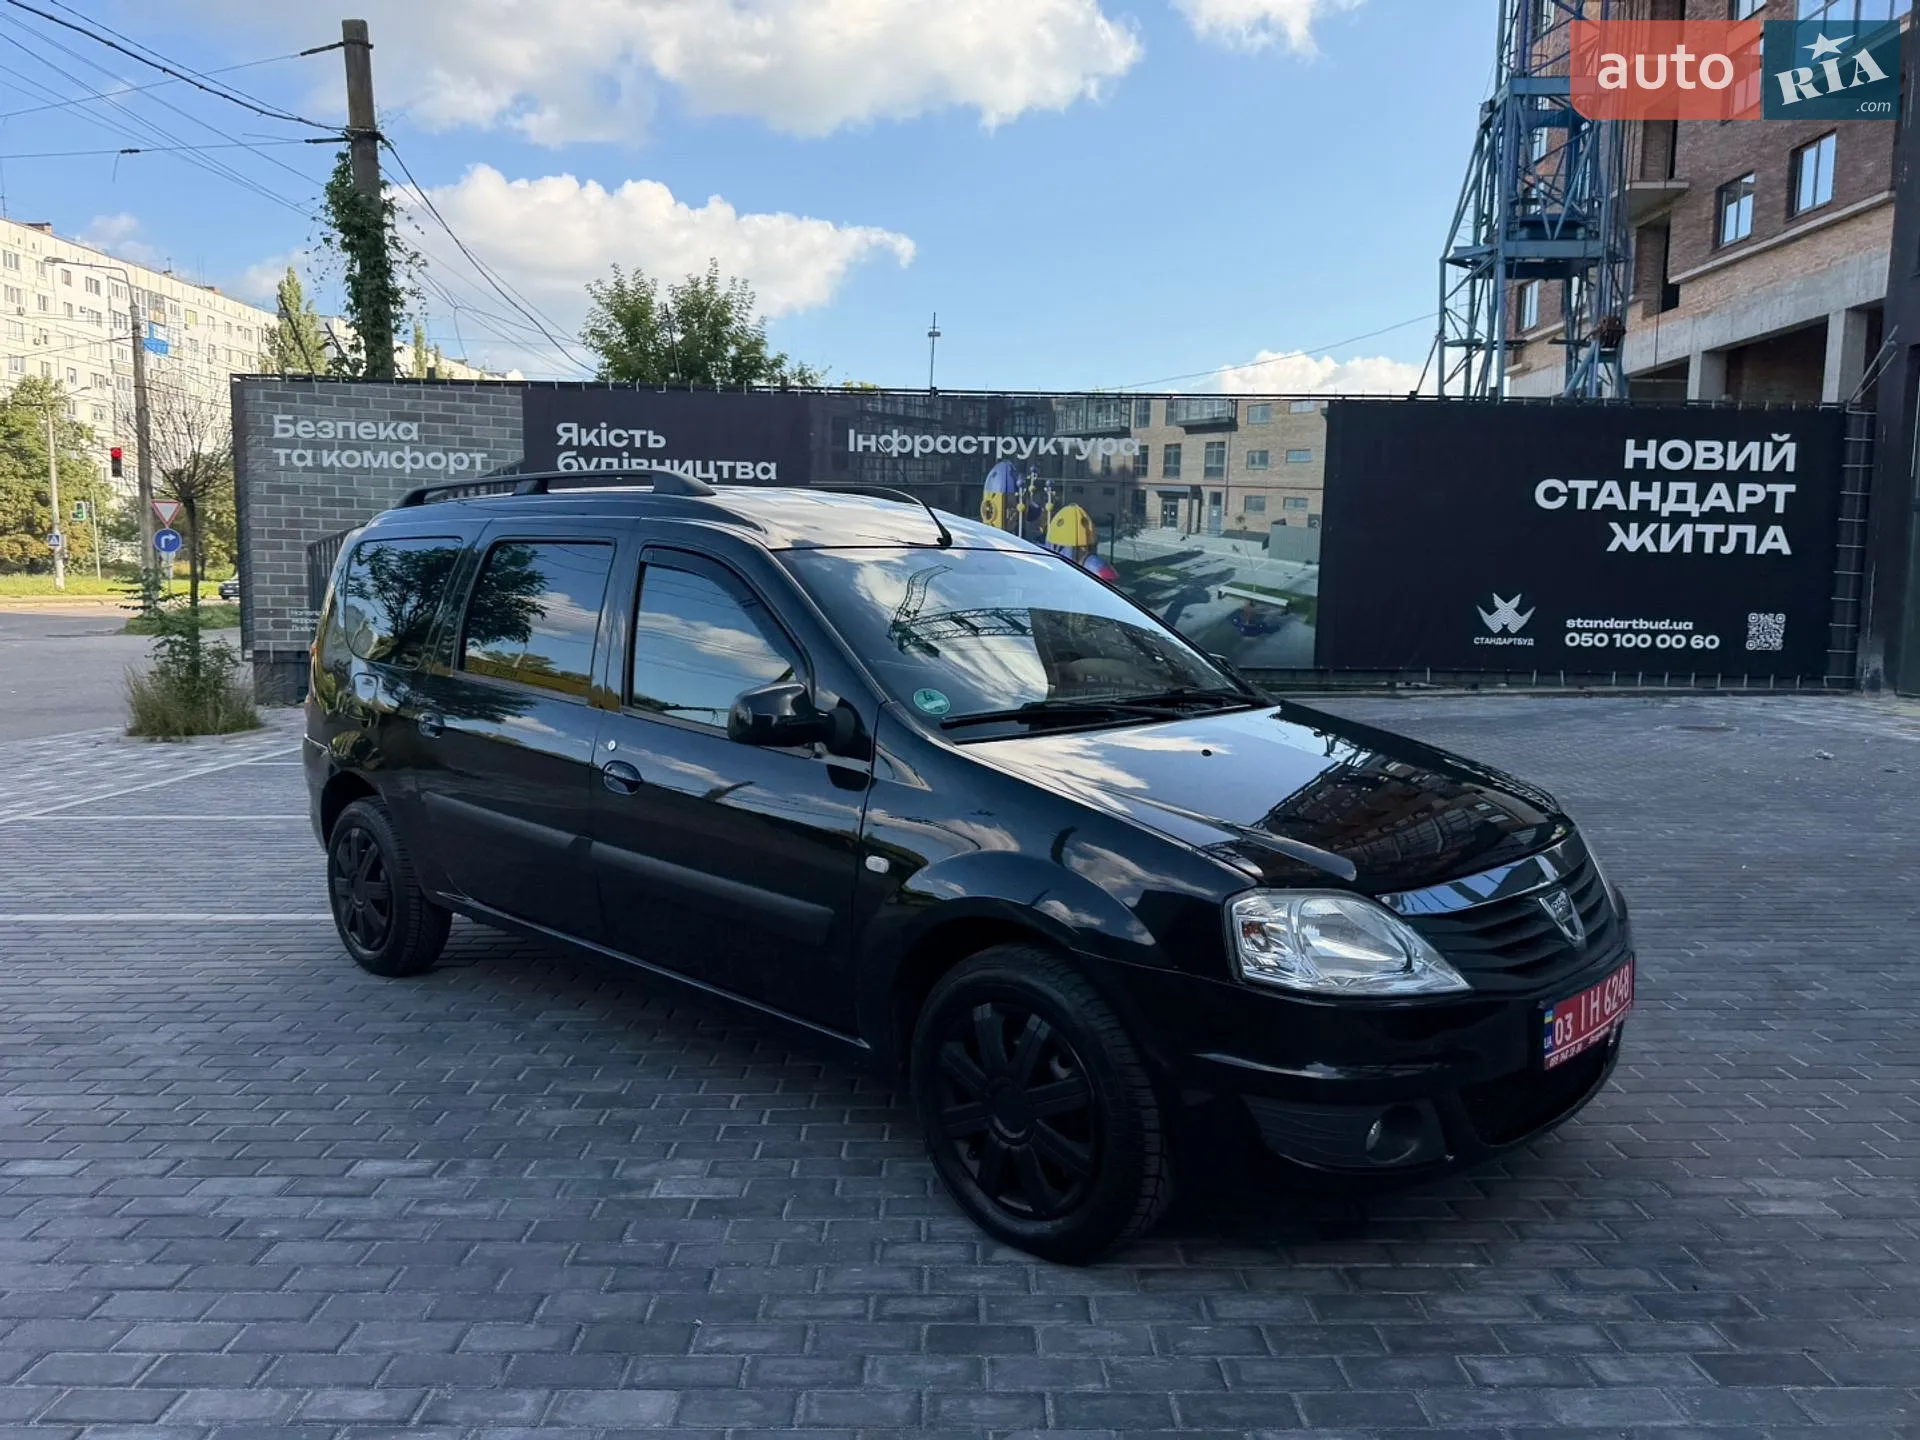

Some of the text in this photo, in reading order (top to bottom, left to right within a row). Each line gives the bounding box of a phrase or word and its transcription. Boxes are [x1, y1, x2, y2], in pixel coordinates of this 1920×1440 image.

[272, 414, 419, 441] Безпека
[556, 422, 666, 448] Якість
[272, 445, 488, 475] та комфорт
[848, 429, 1141, 461] Інфраструктура
[1624, 433, 1797, 472] НОВИЙ
[1534, 478, 1797, 518] СТАНДАРТ
[1606, 522, 1792, 556] ЖИТЛА
[1565, 617, 1694, 631] standartbud.ua
[1473, 637, 1535, 646] СТАНДАРТБУД
[1564, 632, 1720, 650] 050 100 00 60
[1555, 1012, 1574, 1047] 03
